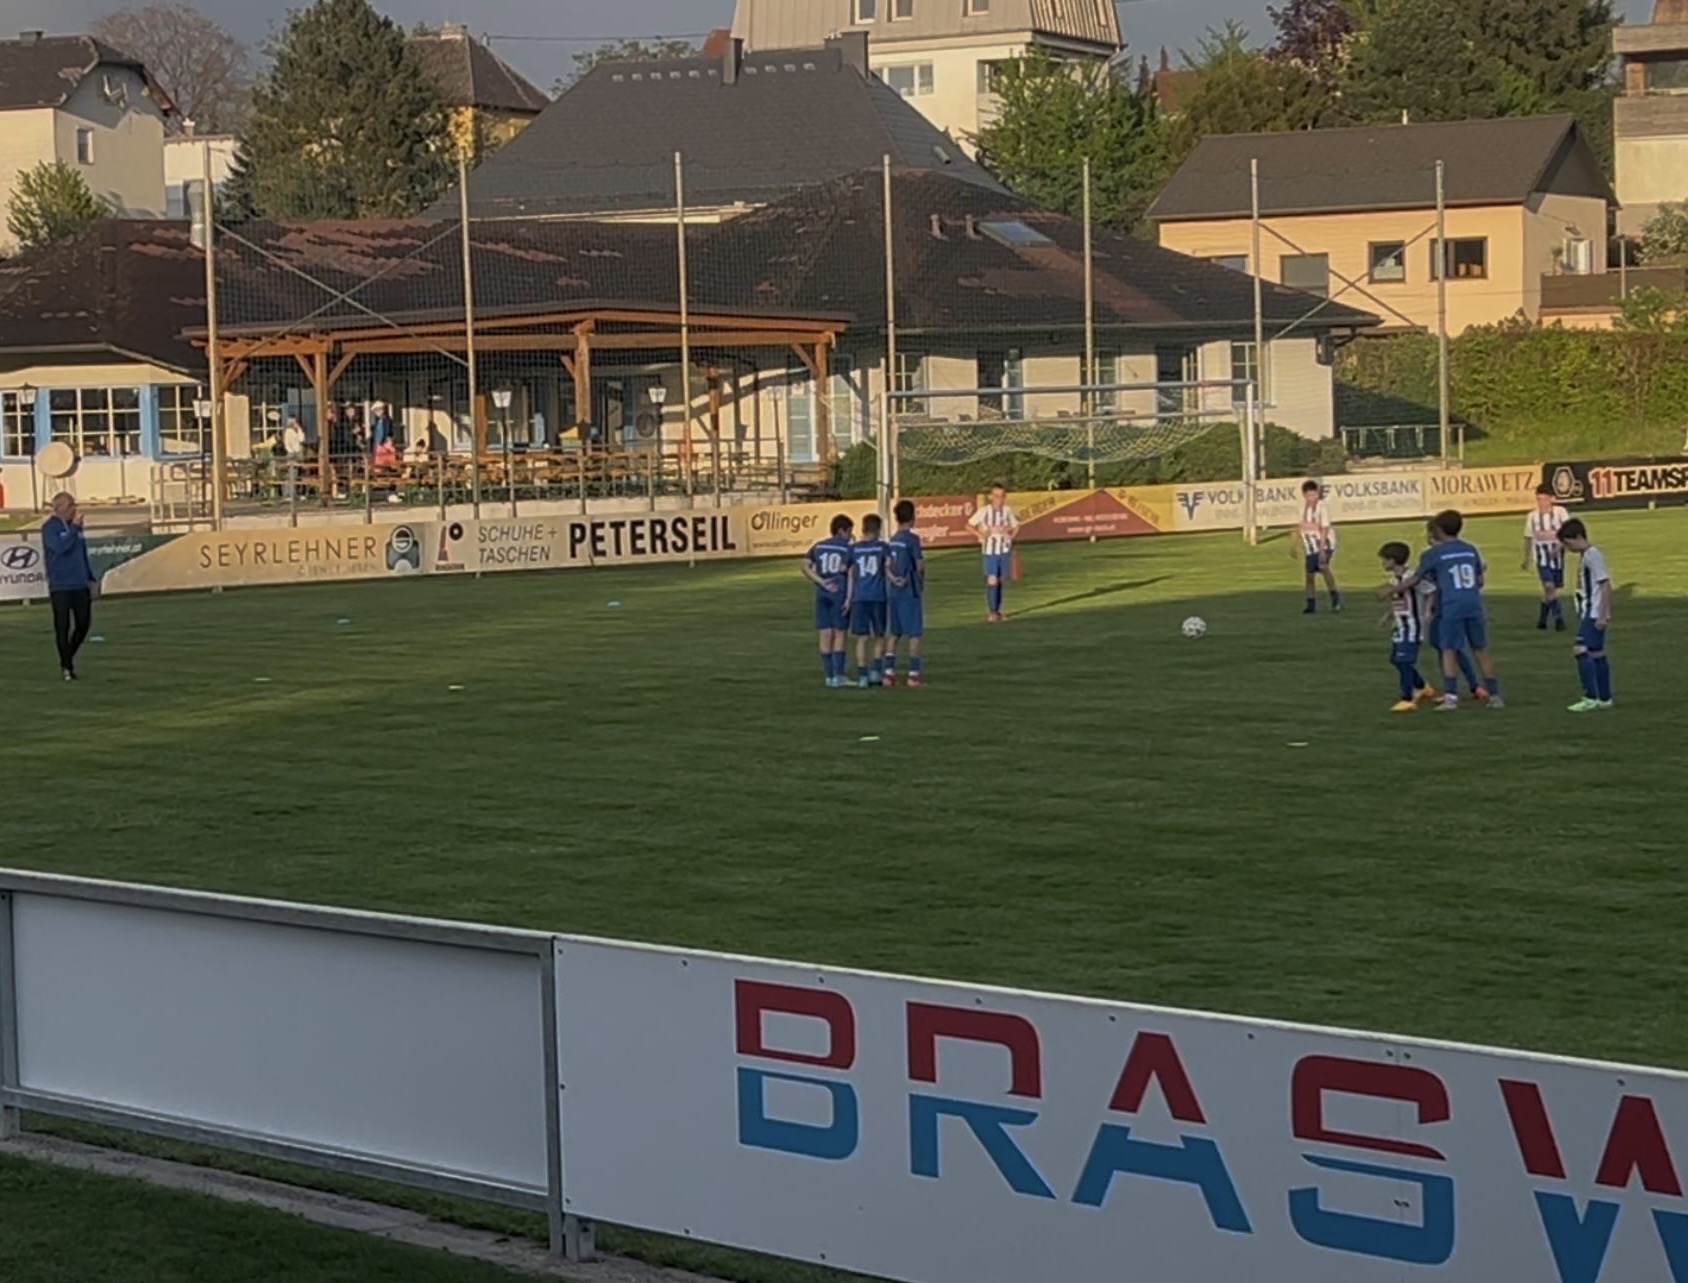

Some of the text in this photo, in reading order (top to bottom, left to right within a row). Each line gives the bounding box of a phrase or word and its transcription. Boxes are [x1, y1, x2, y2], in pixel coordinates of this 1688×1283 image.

[1334, 479, 1419, 498] VOLKSBANK
[1431, 471, 1537, 495] MORAWETZ
[1207, 486, 1298, 505] VOLKBANK
[478, 523, 544, 543] SCHUHE
[569, 515, 736, 558] PETERSEIL
[199, 536, 377, 569] SEYRLEHNER
[478, 545, 551, 564] TASCHEN
[819, 552, 841, 574] 10
[857, 555, 878, 577] 14
[1449, 564, 1475, 589] 19
